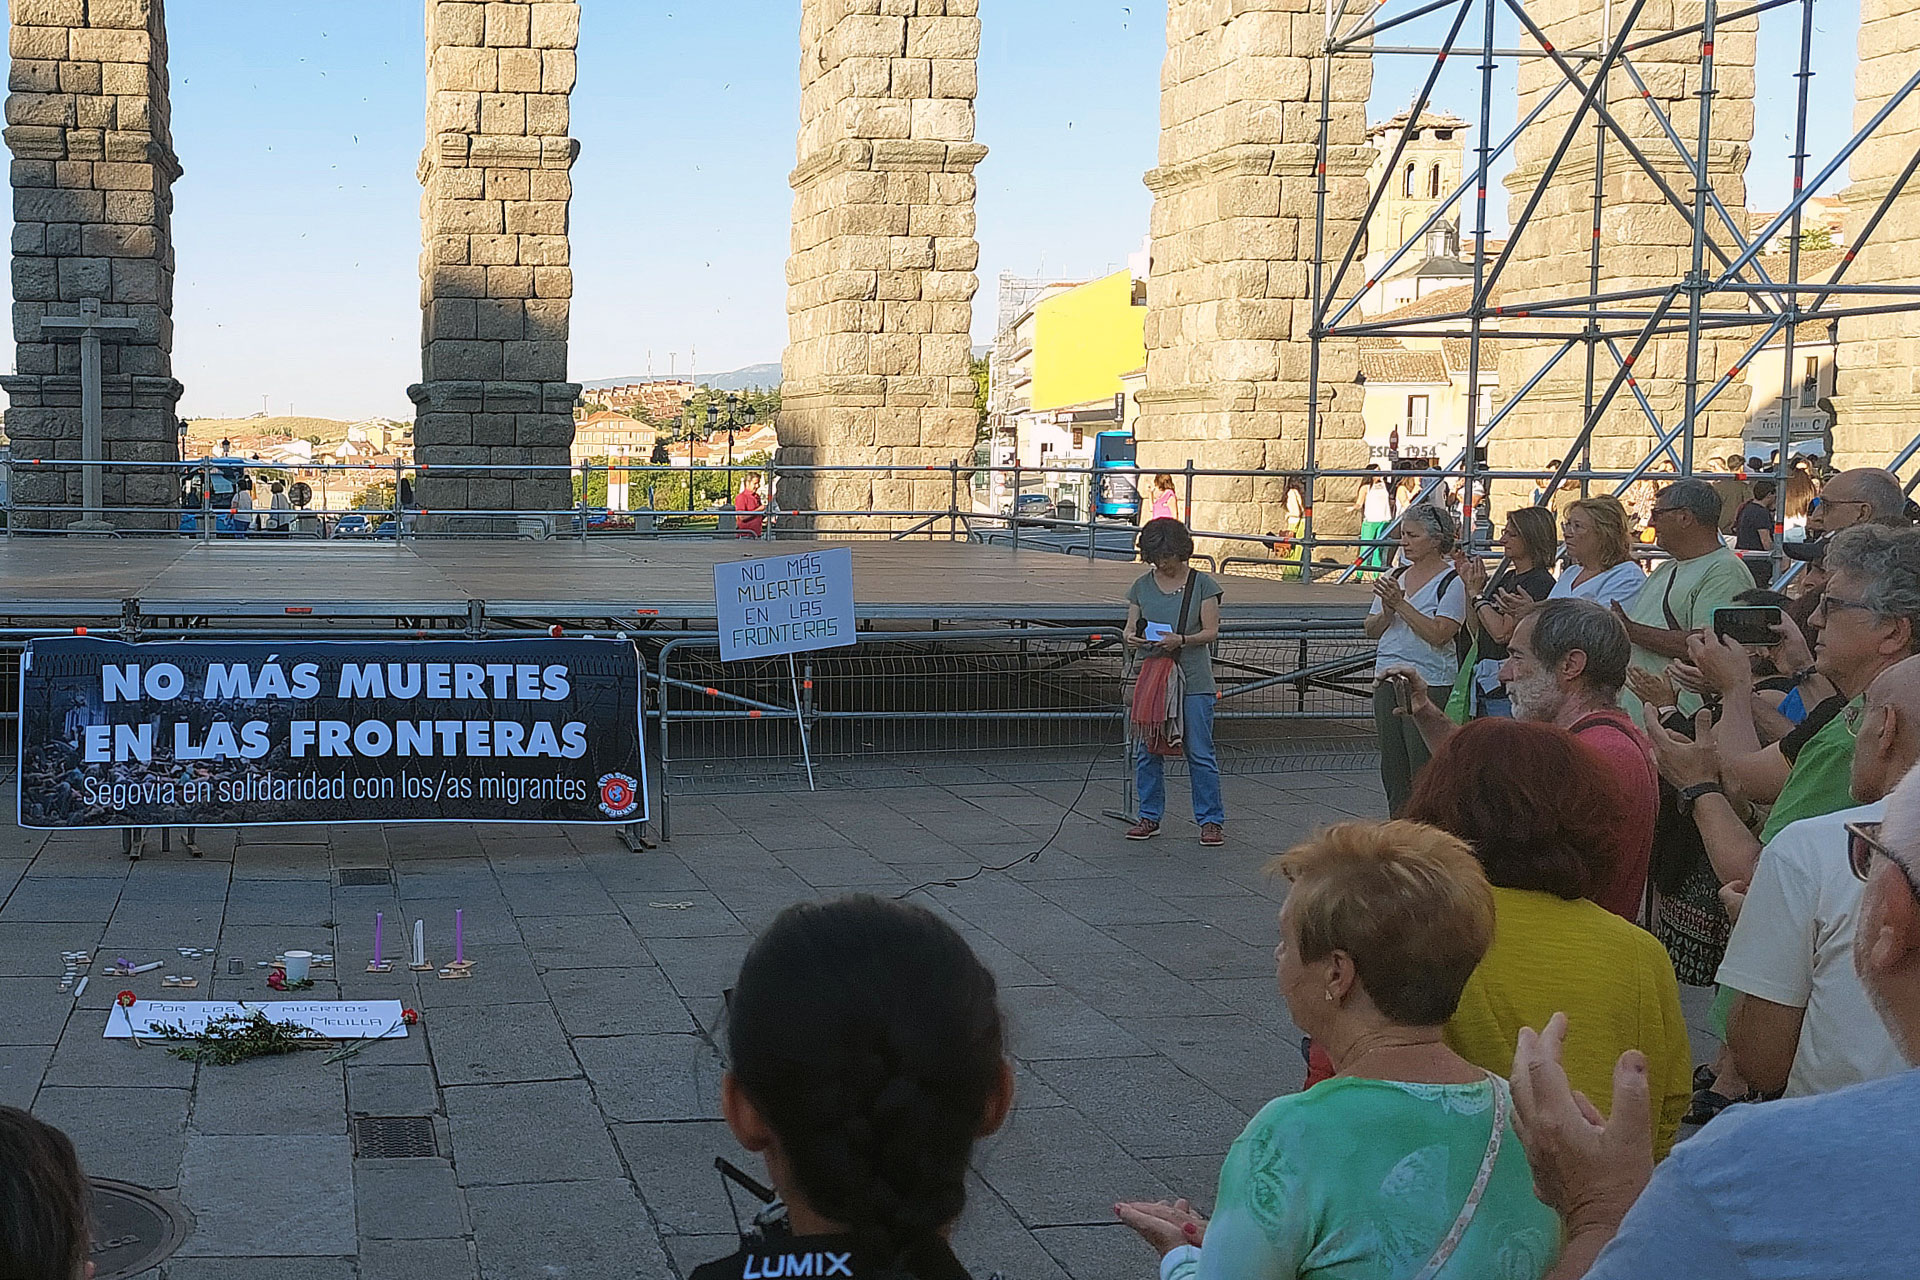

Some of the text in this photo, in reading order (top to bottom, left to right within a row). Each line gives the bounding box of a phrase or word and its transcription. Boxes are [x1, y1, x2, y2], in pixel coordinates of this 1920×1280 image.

[1405, 446, 1437, 458] 1954
[741, 554, 821, 582] NO MÁS
[737, 576, 826, 603] MUERTES
[745, 600, 822, 625] EN LAS
[732, 617, 838, 648] FRONTERAS
[102, 654, 571, 702] NO MÁS MUERTES
[84, 719, 588, 762] EN LAS FRONTERAS
[83, 769, 587, 811] Segovia en solidaridad con los/as migrantes
[282, 1005, 368, 1013] MUERTOS
[743, 1252, 853, 1280] LUMIX
